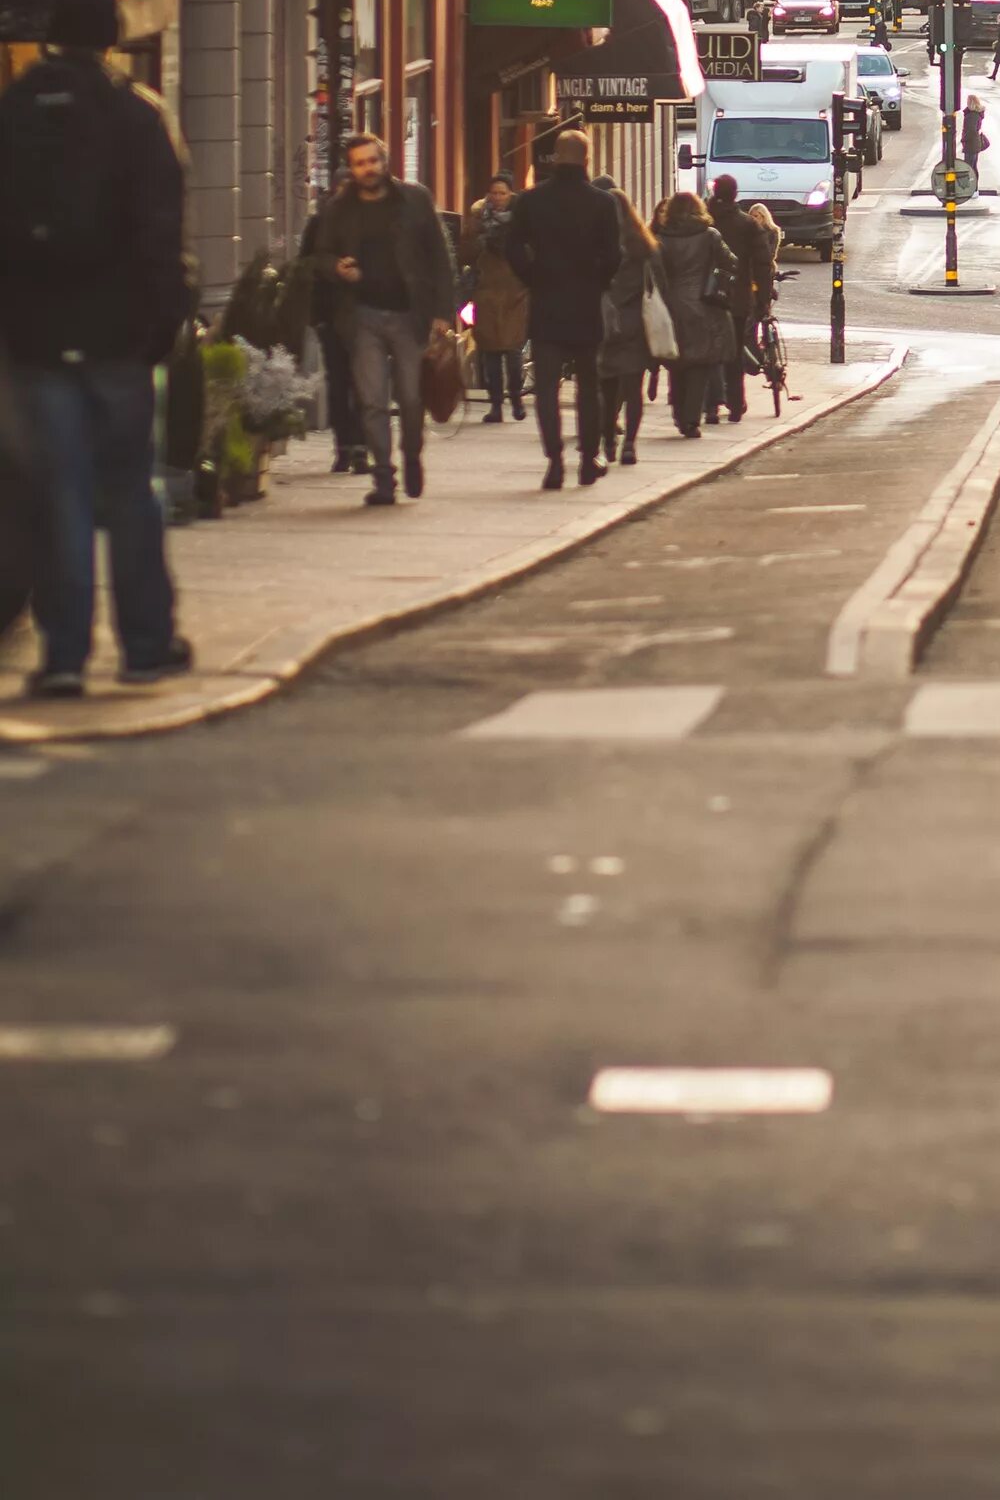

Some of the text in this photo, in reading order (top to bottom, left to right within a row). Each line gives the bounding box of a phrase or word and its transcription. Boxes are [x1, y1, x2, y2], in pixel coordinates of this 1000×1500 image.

[597, 77, 648, 97] VINTAGE
[590, 102, 648, 113] dam & herr
